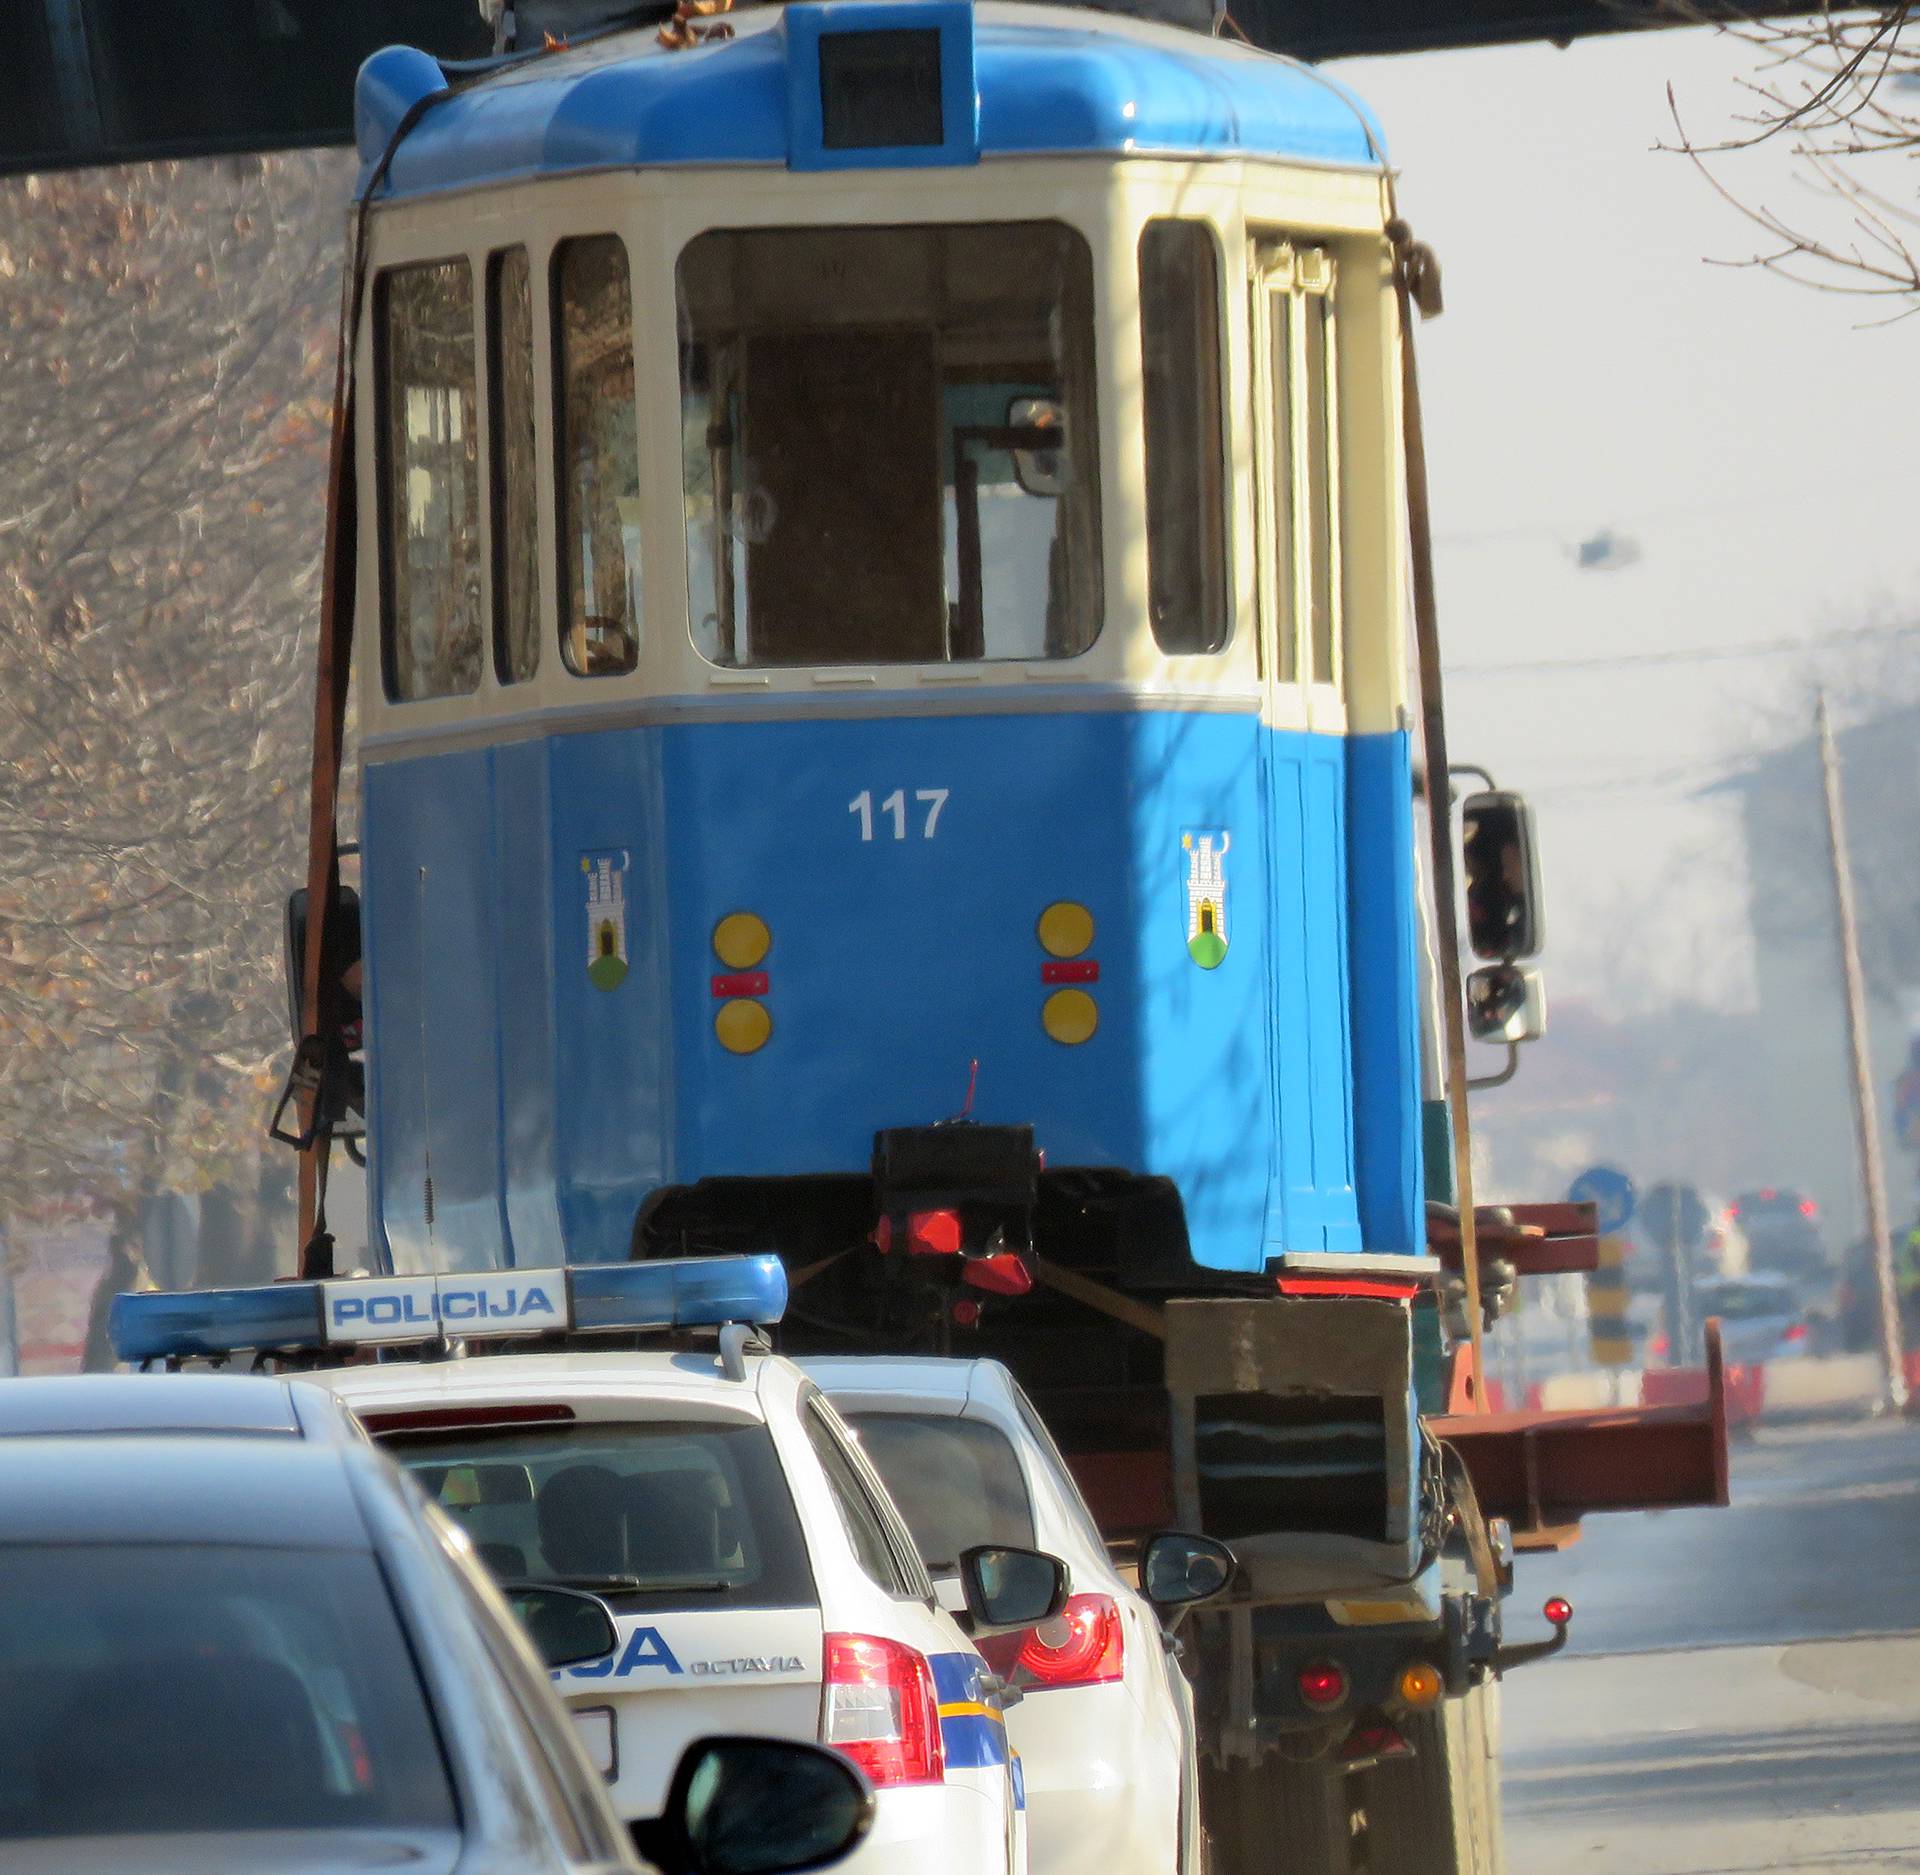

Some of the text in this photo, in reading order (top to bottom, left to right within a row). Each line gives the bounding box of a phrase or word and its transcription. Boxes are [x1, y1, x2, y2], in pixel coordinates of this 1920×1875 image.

[848, 788, 950, 841] 117
[333, 1287, 555, 1327] POLICIJA
[691, 1656, 806, 1676] OCTAVIA
